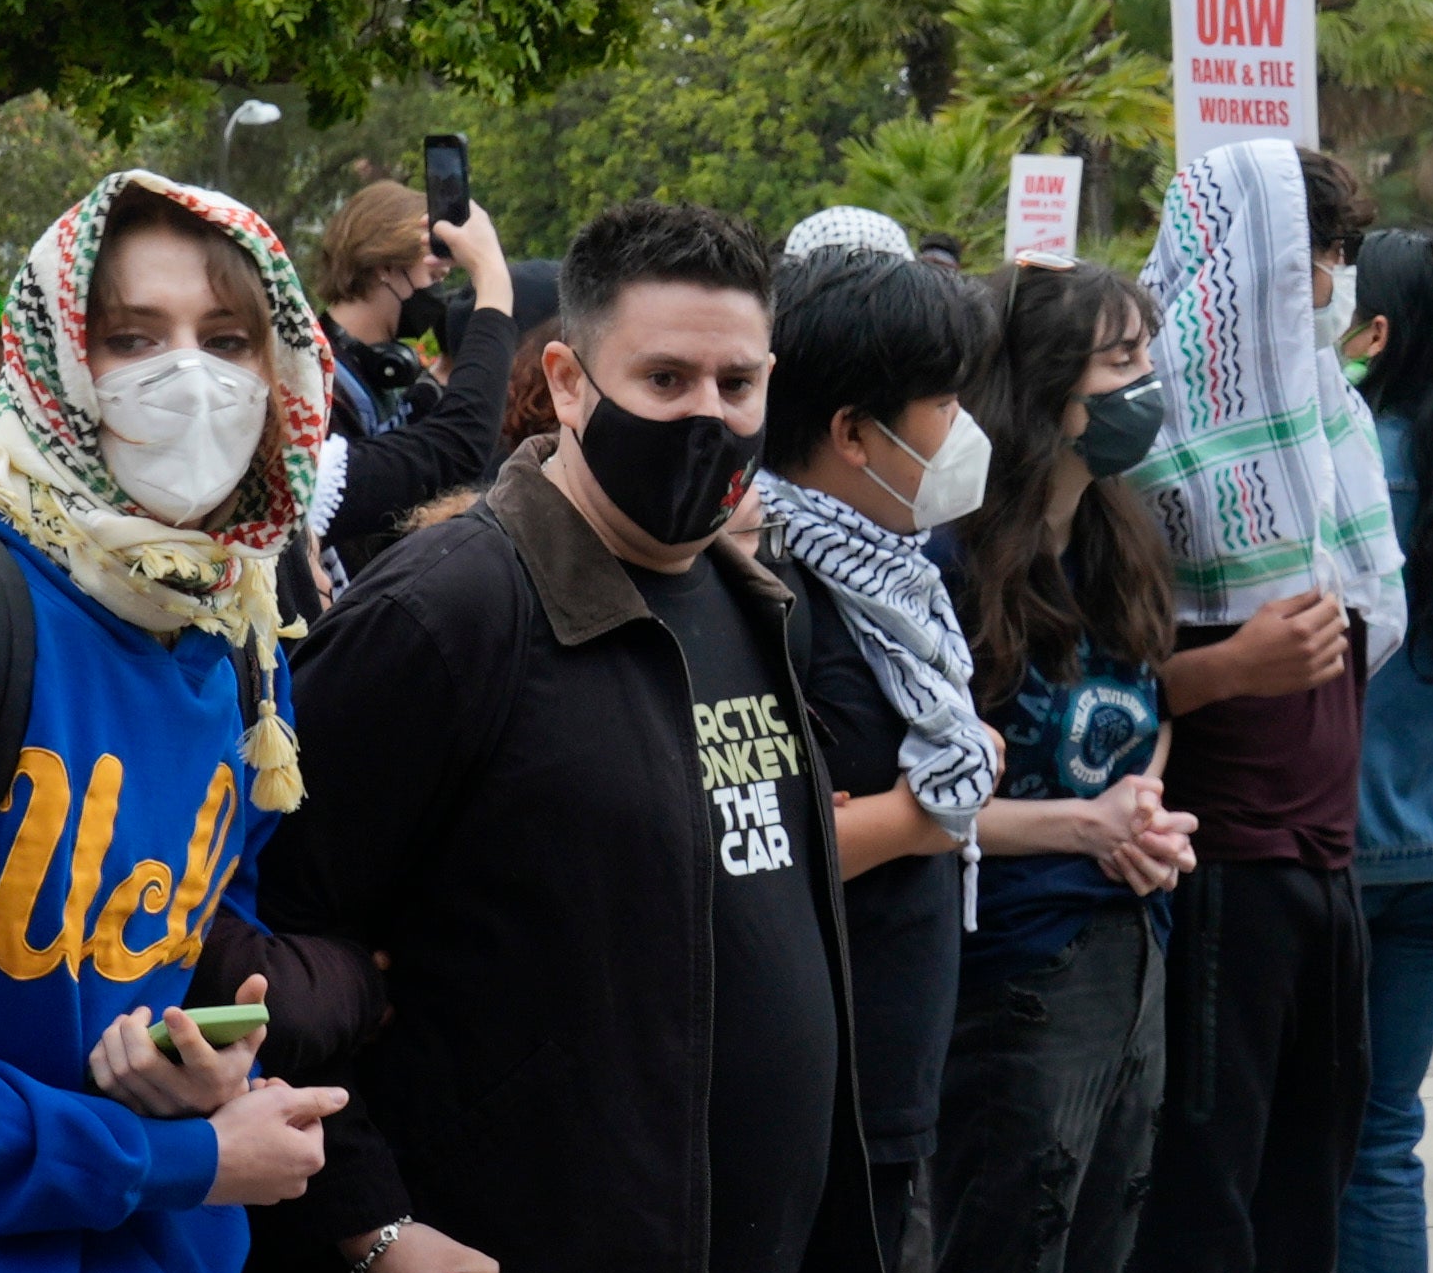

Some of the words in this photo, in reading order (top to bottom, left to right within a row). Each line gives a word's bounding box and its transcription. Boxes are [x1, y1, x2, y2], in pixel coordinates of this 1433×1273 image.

[1192, 58, 1238, 86] RANK
[1242, 63, 1254, 86] &
[1260, 60, 1295, 87] FILE
[1199, 97, 1290, 127] WORKERS
[1025, 175, 1065, 194] UAW
[693, 693, 789, 746] RCTIC
[712, 780, 782, 831] THE
[720, 824, 793, 876] CAR
